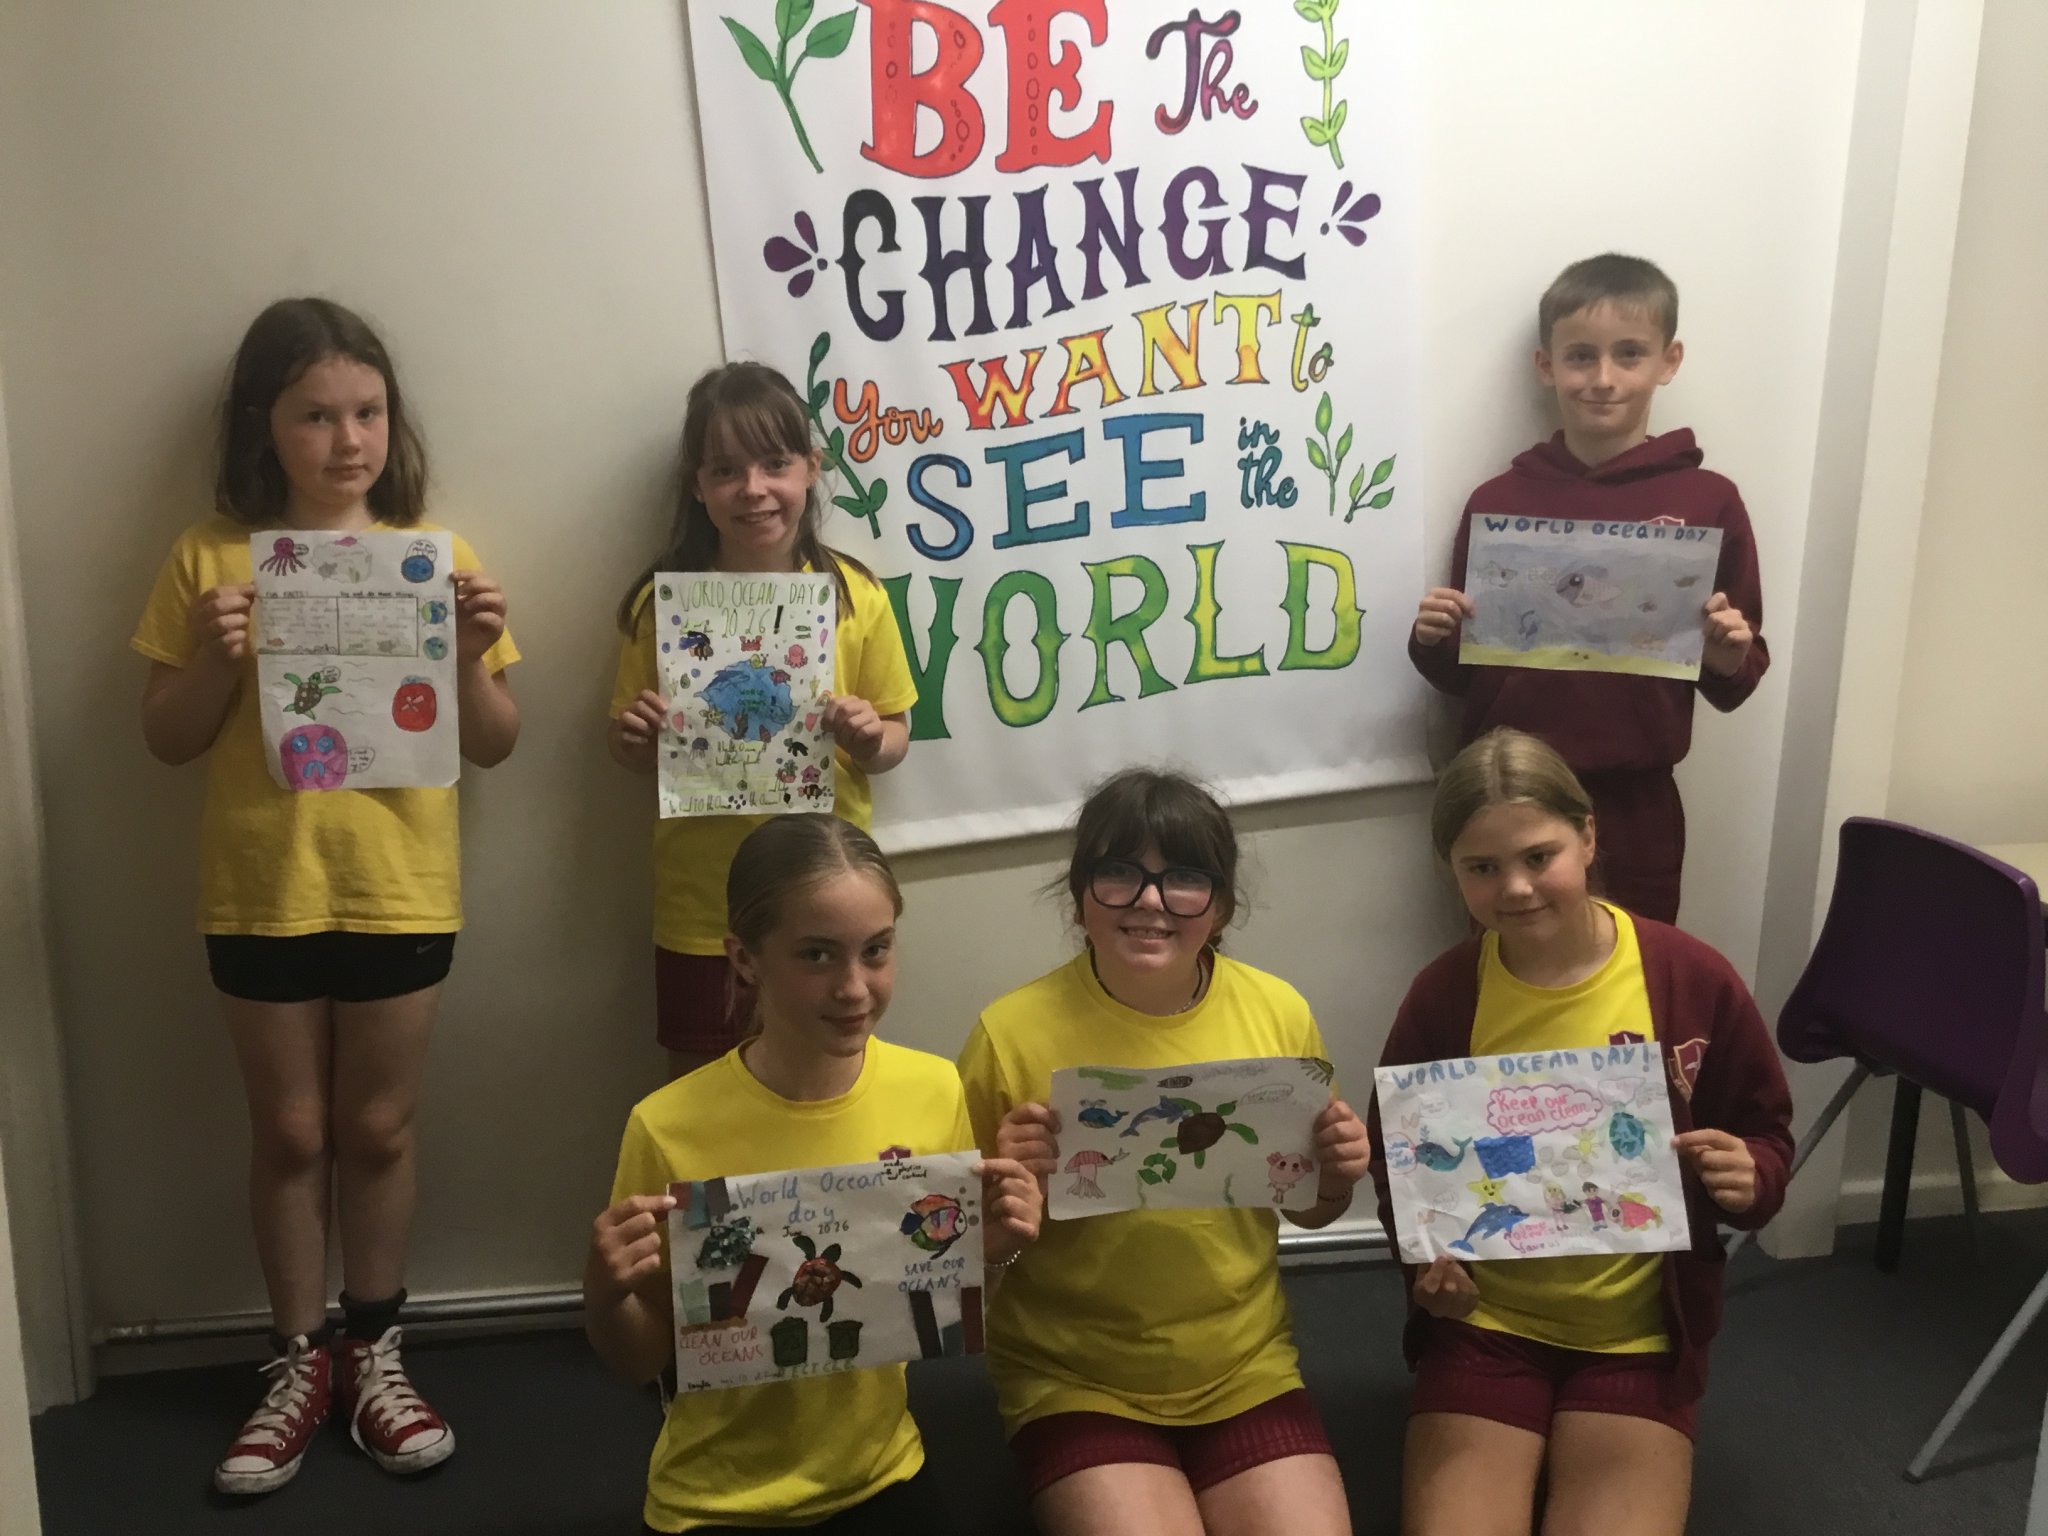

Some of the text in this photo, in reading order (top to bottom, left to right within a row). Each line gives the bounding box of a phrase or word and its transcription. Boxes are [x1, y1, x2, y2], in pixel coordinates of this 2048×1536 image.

[858, 0, 1258, 178] BE The
[835, 163, 1308, 342] CHANGE
[938, 288, 1282, 431] WANT
[1290, 302, 1334, 392] to
[1237, 416, 1280, 450] in
[906, 412, 1206, 561] SEE
[1237, 445, 1298, 509] the
[732, 580, 778, 607] OCEAN
[788, 583, 815, 605] DAY
[1391, 1060, 1477, 1090] WORLD
[736, 1171, 885, 1208] World Ocean
[788, 1200, 835, 1225] day
[817, 1219, 850, 1235] 2026
[904, 1256, 966, 1277] SAVE OUR
[730, 1325, 758, 1344] OUR
